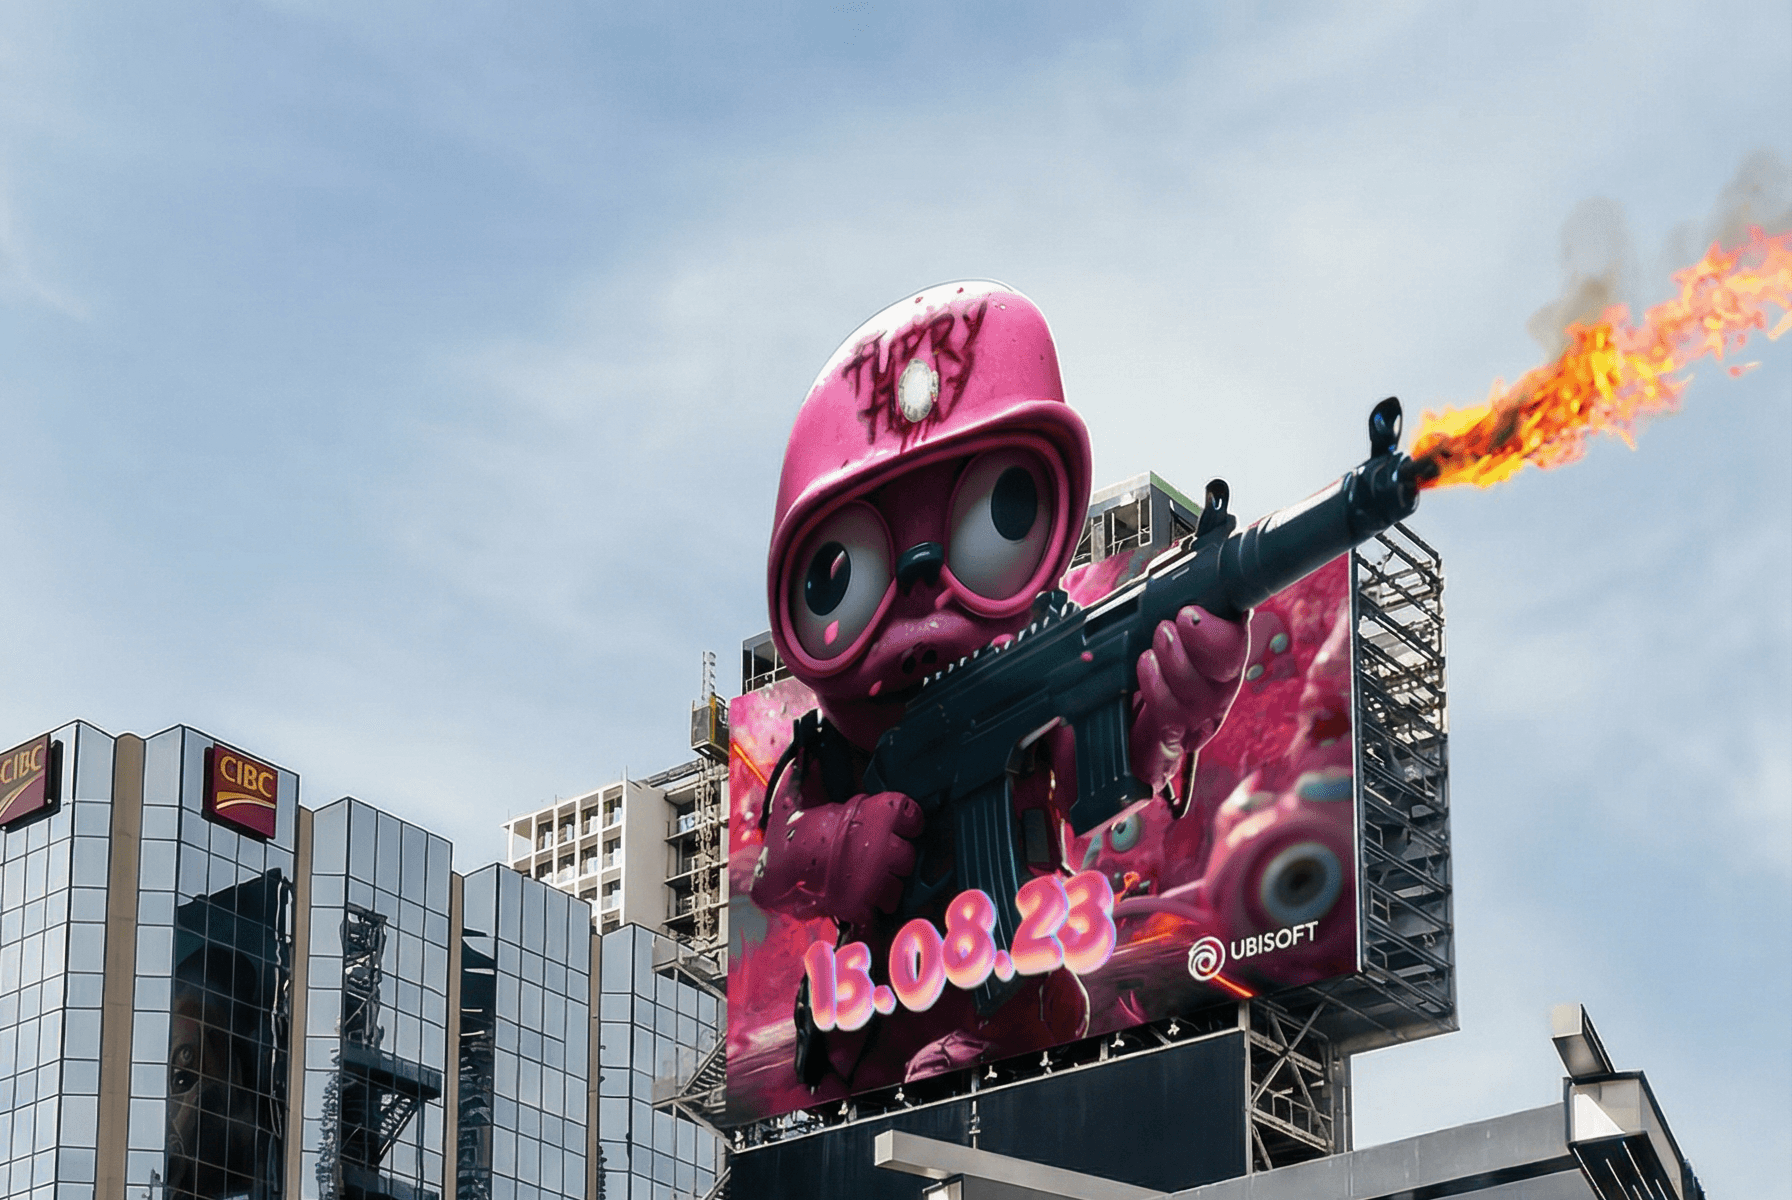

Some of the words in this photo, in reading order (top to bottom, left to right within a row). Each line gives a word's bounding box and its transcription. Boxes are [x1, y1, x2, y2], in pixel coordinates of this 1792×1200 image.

[0, 744, 43, 784] CIBC
[220, 756, 273, 797] CIBC
[803, 869, 1116, 1031] 15.08.23
[1230, 920, 1319, 961] UBISOFT
